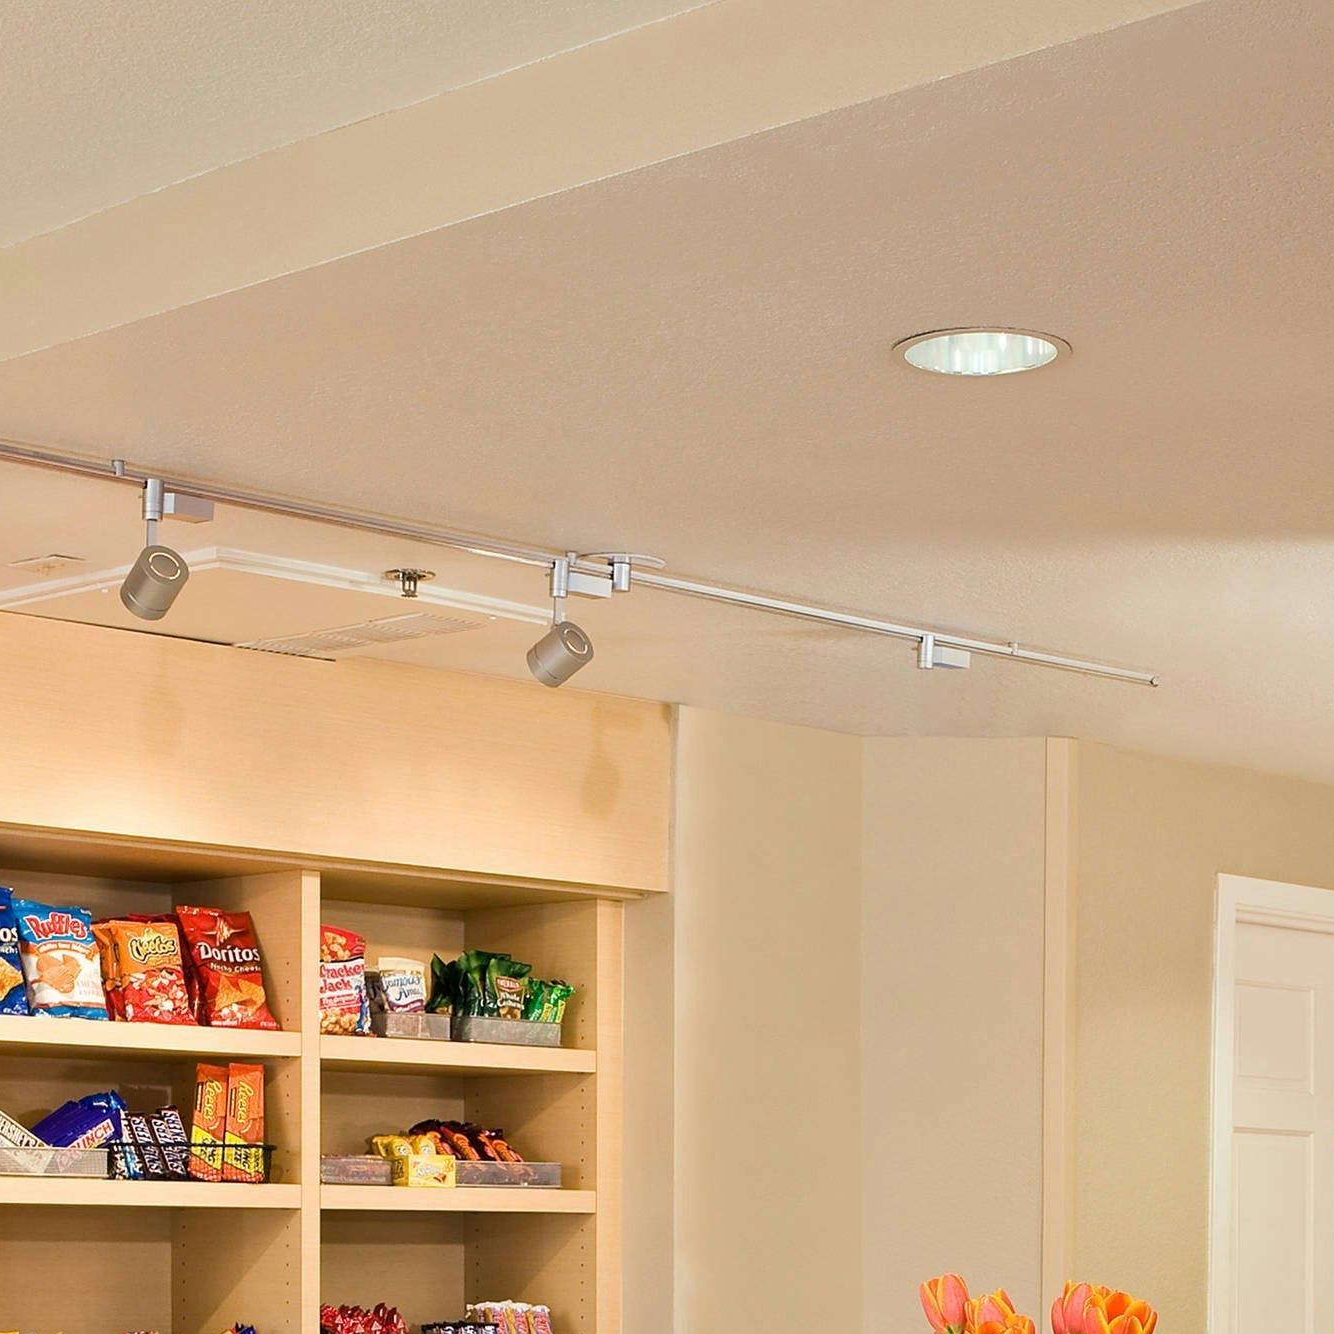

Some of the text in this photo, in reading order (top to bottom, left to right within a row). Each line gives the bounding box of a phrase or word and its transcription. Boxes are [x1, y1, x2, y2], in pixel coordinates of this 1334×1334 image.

[24, 912, 88, 939] Ruffles
[129, 936, 177, 962] Cheetos
[197, 942, 261, 962] Doritos
[320, 978, 352, 993] Jack
